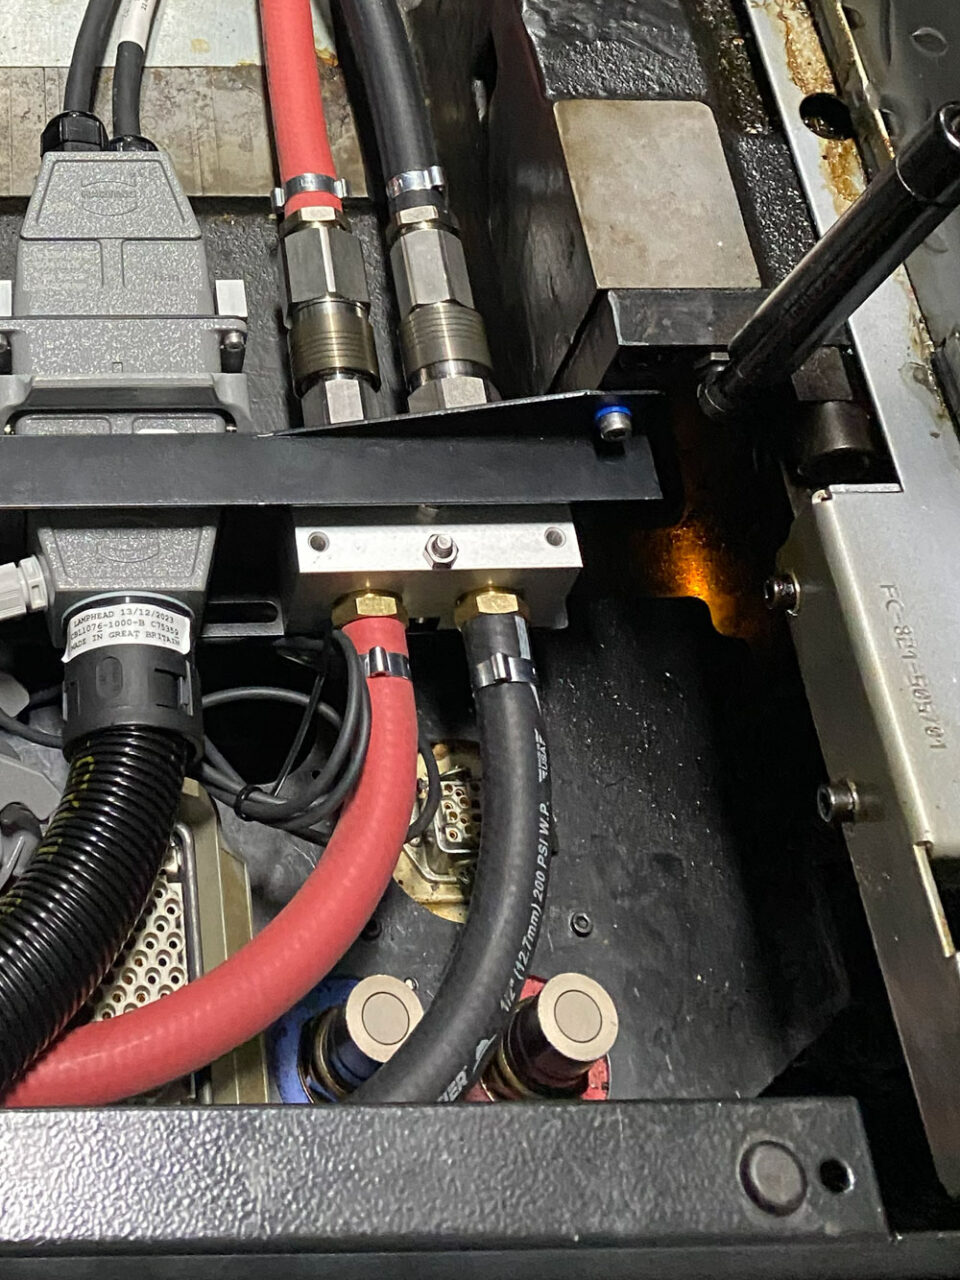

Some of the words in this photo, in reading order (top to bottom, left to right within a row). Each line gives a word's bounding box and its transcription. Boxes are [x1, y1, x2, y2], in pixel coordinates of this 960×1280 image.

[73, 610, 115, 628] LAMPHEAD
[120, 607, 175, 624] 13/12/2023
[70, 637, 87, 651] MADE
[92, 632, 103, 642] IN
[108, 629, 141, 640] GREAT
[145, 630, 181, 646] BRITAIN
[539, 801, 550, 836] W.P.
[537, 838, 549, 869] PSI
[533, 870, 546, 902] 200
[513, 903, 542, 981] (12.7mm)
